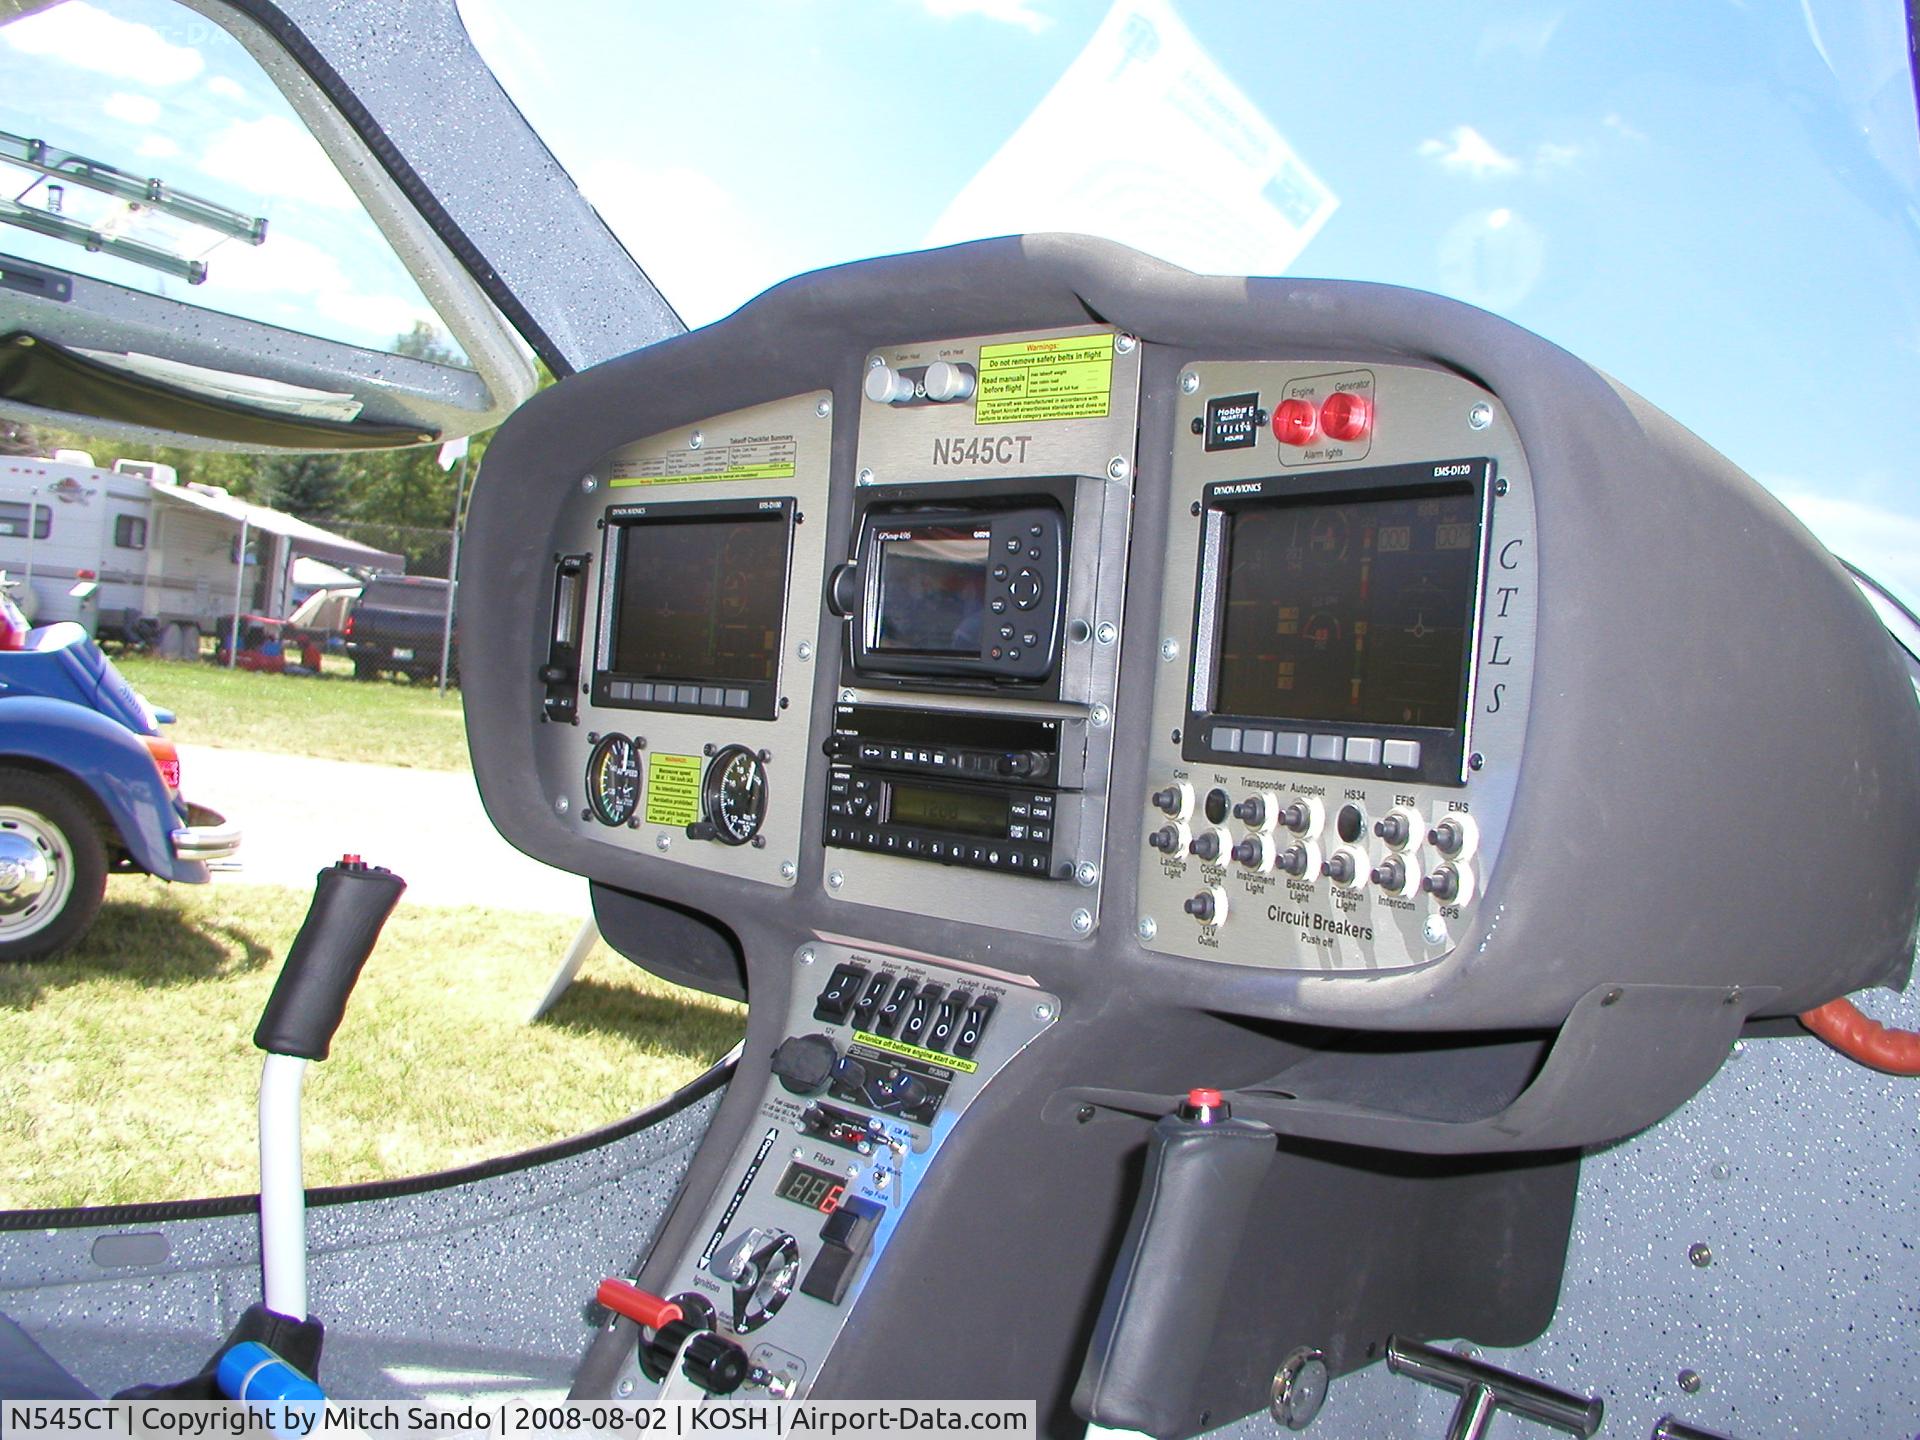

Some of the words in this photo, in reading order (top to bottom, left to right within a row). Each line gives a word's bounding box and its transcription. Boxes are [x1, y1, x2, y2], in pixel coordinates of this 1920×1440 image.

[1037, 355, 1056, 364] safety
[1084, 351, 1101, 360] flight
[982, 376, 997, 384] Read
[999, 374, 1025, 383] manuals
[1005, 385, 1022, 394] flight
[1292, 386, 1315, 397] Engine
[1334, 379, 1370, 392] Generator
[933, 436, 1032, 465] N545CT
[1304, 449, 1321, 460] Alarm
[1324, 447, 1343, 461] lights
[1434, 465, 1470, 477] EMS-D120
[1173, 770, 1188, 779] Com
[1214, 774, 1227, 784] Nav
[1241, 777, 1286, 791] Transponder
[1290, 783, 1325, 797] Autopilot
[1344, 789, 1365, 801] HS34
[1395, 795, 1415, 807] EFIS
[1012, 806, 1025, 814] FUNC
[1033, 808, 1047, 816] CRSR
[1448, 801, 1468, 813] EMS
[869, 834, 873, 842] 2
[888, 838, 893, 846] 3
[932, 844, 937, 852] 5
[953, 848, 958, 856] 6
[974, 850, 979, 859] 7
[1012, 855, 1017, 864] 8
[1033, 858, 1038, 867] 9
[1160, 857, 1186, 872] Landing
[1164, 867, 1181, 879] Light
[1200, 864, 1227, 877] Cockpit
[1204, 874, 1222, 886] Light
[1236, 870, 1275, 886] Instrument
[1246, 882, 1264, 895] Light
[1286, 879, 1314, 892] Beacon
[1290, 890, 1309, 904] Light
[1331, 887, 1364, 902] Position
[1336, 899, 1356, 912] Light
[1378, 895, 1415, 911] Intercom
[1440, 908, 1459, 920] GPS
[1268, 904, 1309, 928] Circuit
[1313, 913, 1373, 940] Breakers
[1202, 926, 1215, 936] 12V
[1198, 936, 1219, 948] Outlet
[1301, 932, 1320, 946] Push
[1323, 938, 1333, 947] off
[858, 1033, 882, 1044] avionics
[883, 1040, 892, 1048] off
[892, 1041, 911, 1053] before
[912, 1048, 932, 1060] engine
[933, 1053, 948, 1064] start
[957, 1060, 972, 1071] stop
[758, 1140, 772, 1160] Open
[814, 1152, 835, 1167] Flaps
[705, 1232, 722, 1258] Closed
[693, 1275, 720, 1293] Ignition
